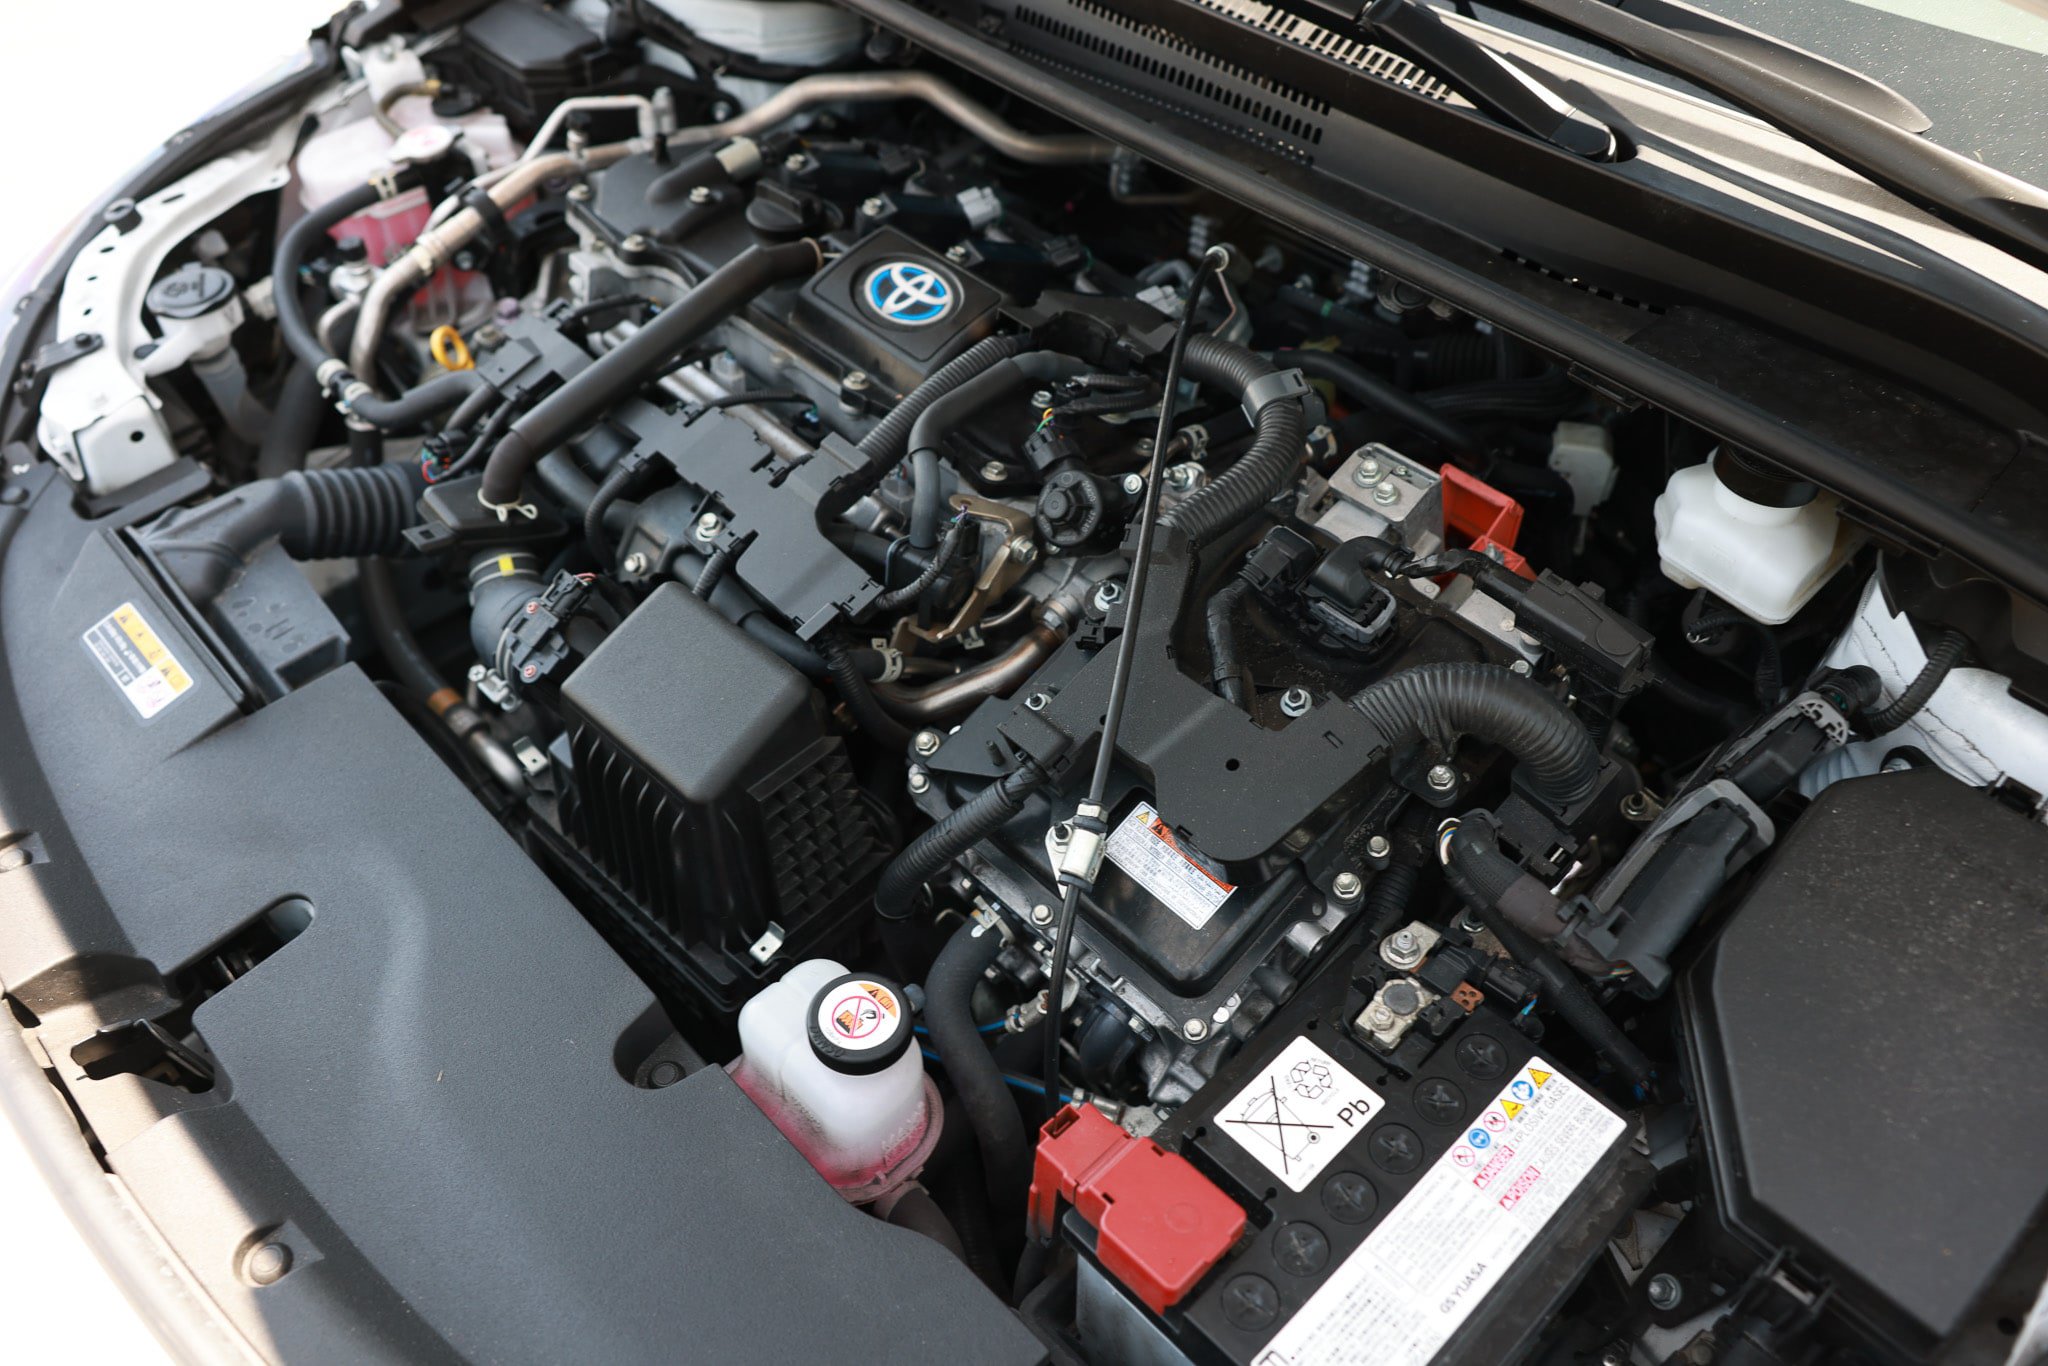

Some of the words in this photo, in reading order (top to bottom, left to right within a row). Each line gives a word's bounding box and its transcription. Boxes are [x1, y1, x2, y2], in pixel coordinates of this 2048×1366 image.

[1337, 1099, 1371, 1128] Pb
[1481, 1145, 1515, 1182] DANGER
[1510, 1111, 1548, 1148] EXPLOSIVE
[1546, 1084, 1571, 1111] GASES
[1508, 1166, 1540, 1201] POISON
[1555, 1123, 1579, 1147] SEVERE
[1574, 1102, 1596, 1126] BURNS
[1439, 1297, 1456, 1314] GS
[1454, 1262, 1487, 1298] YUASA
